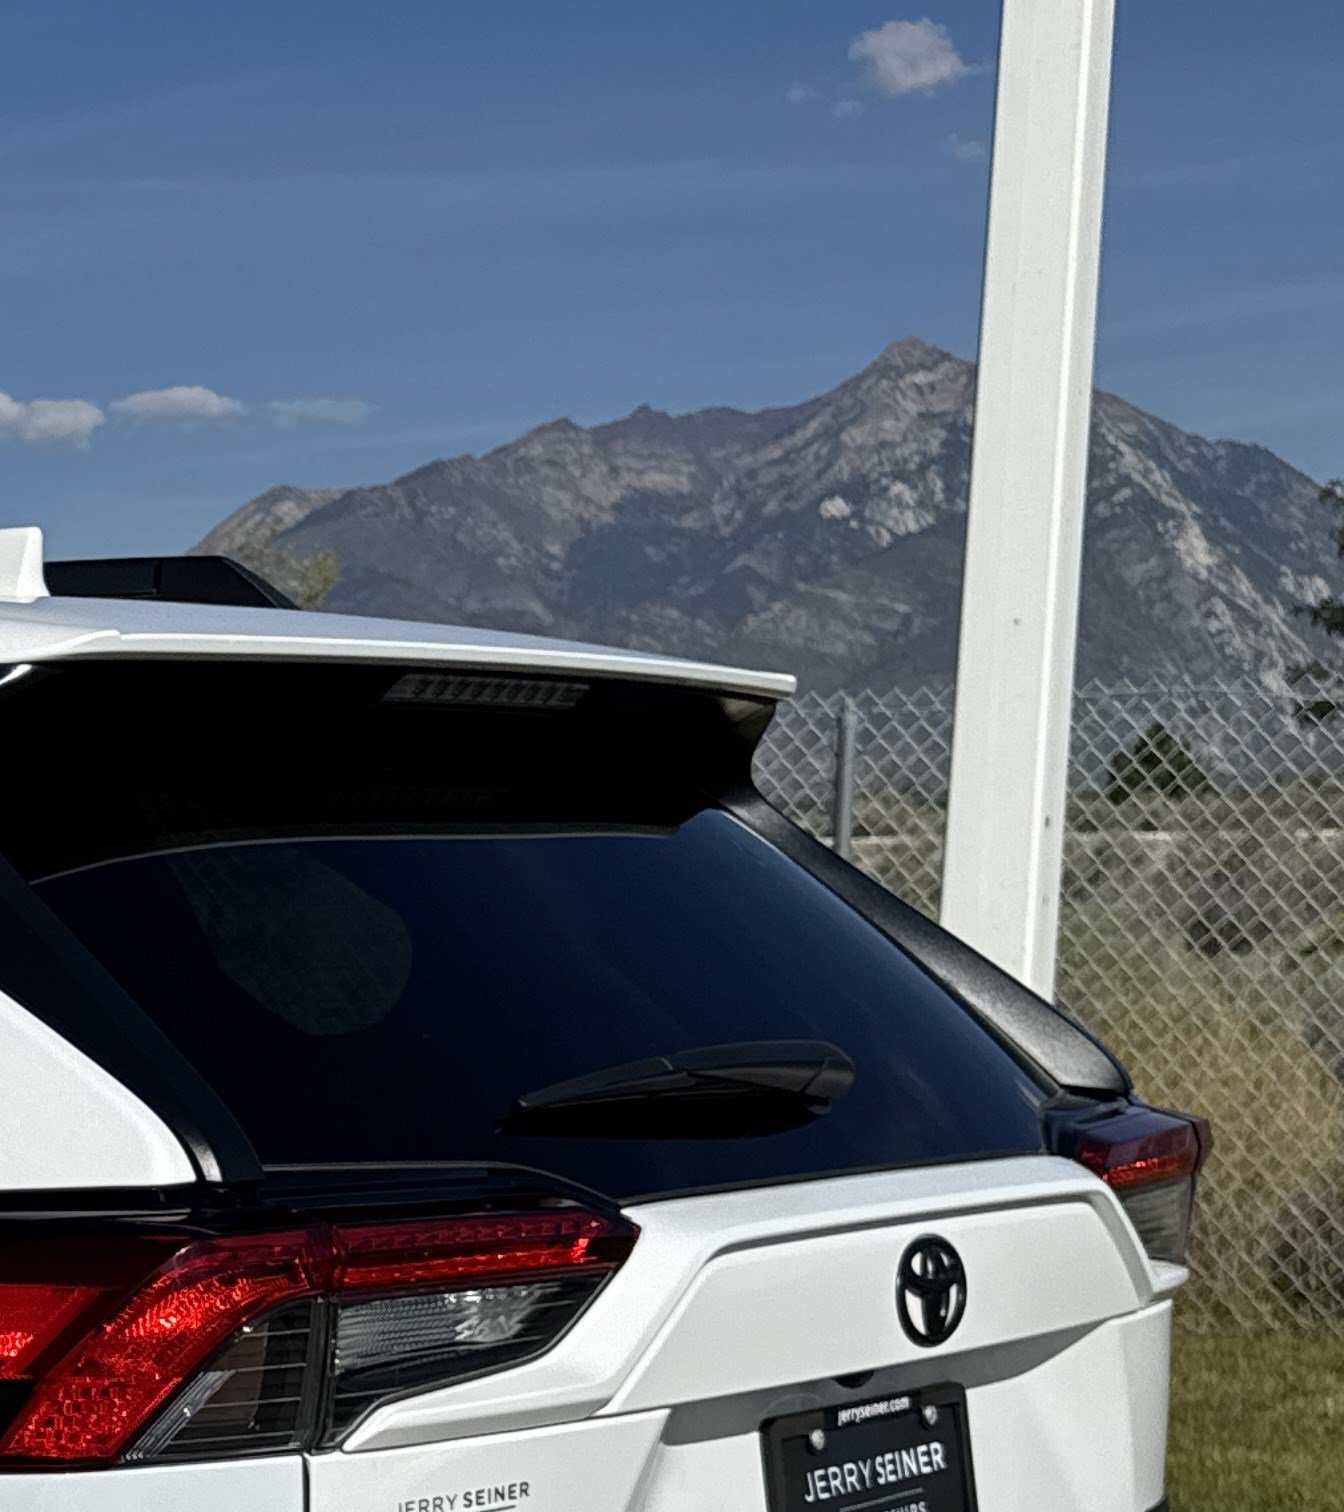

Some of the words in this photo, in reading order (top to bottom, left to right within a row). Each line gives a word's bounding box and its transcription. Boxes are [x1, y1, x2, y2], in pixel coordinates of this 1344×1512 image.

[804, 1457, 871, 1503] JERRY
[874, 1441, 947, 1485] SEINER
[462, 1481, 531, 1509] SEINER
